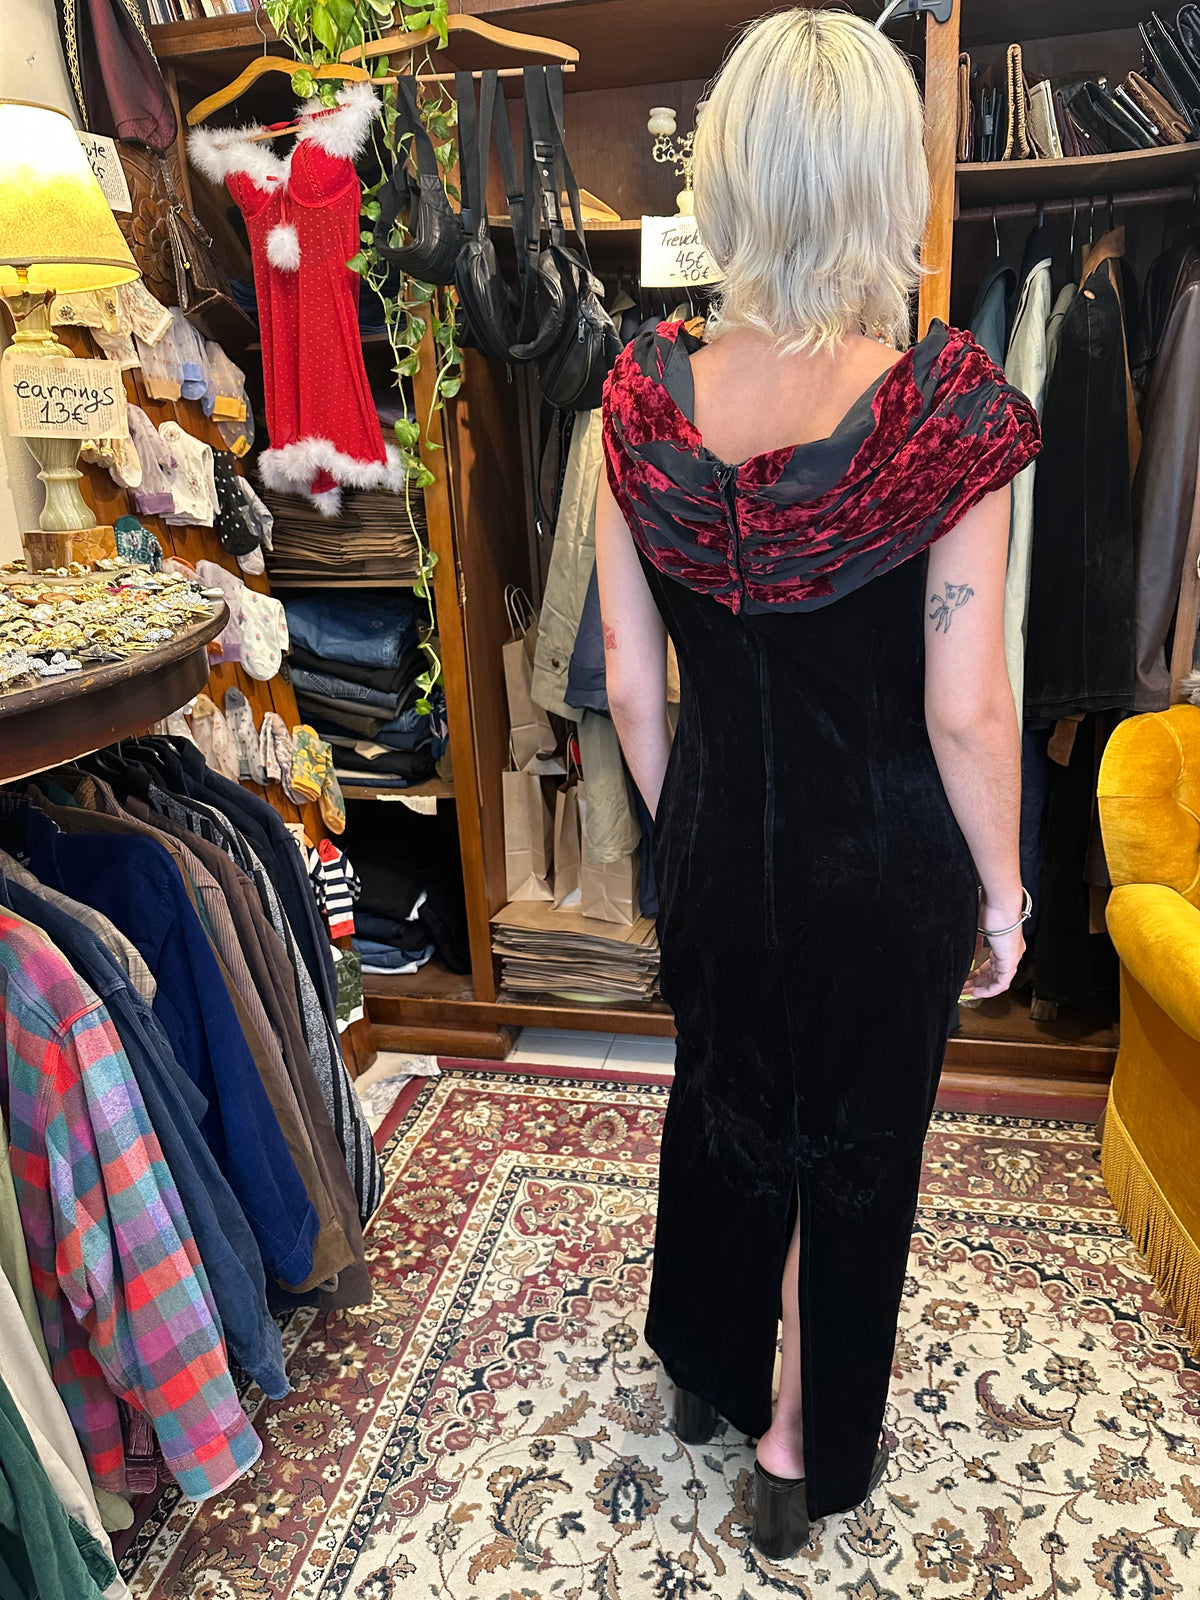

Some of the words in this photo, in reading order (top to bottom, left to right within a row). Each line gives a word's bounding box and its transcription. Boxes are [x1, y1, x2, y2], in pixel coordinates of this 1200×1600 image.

[81, 141, 107, 159] ute
[675, 251, 706, 270] 45€
[13, 380, 115, 413] earrings
[39, 400, 88, 425] 13€
